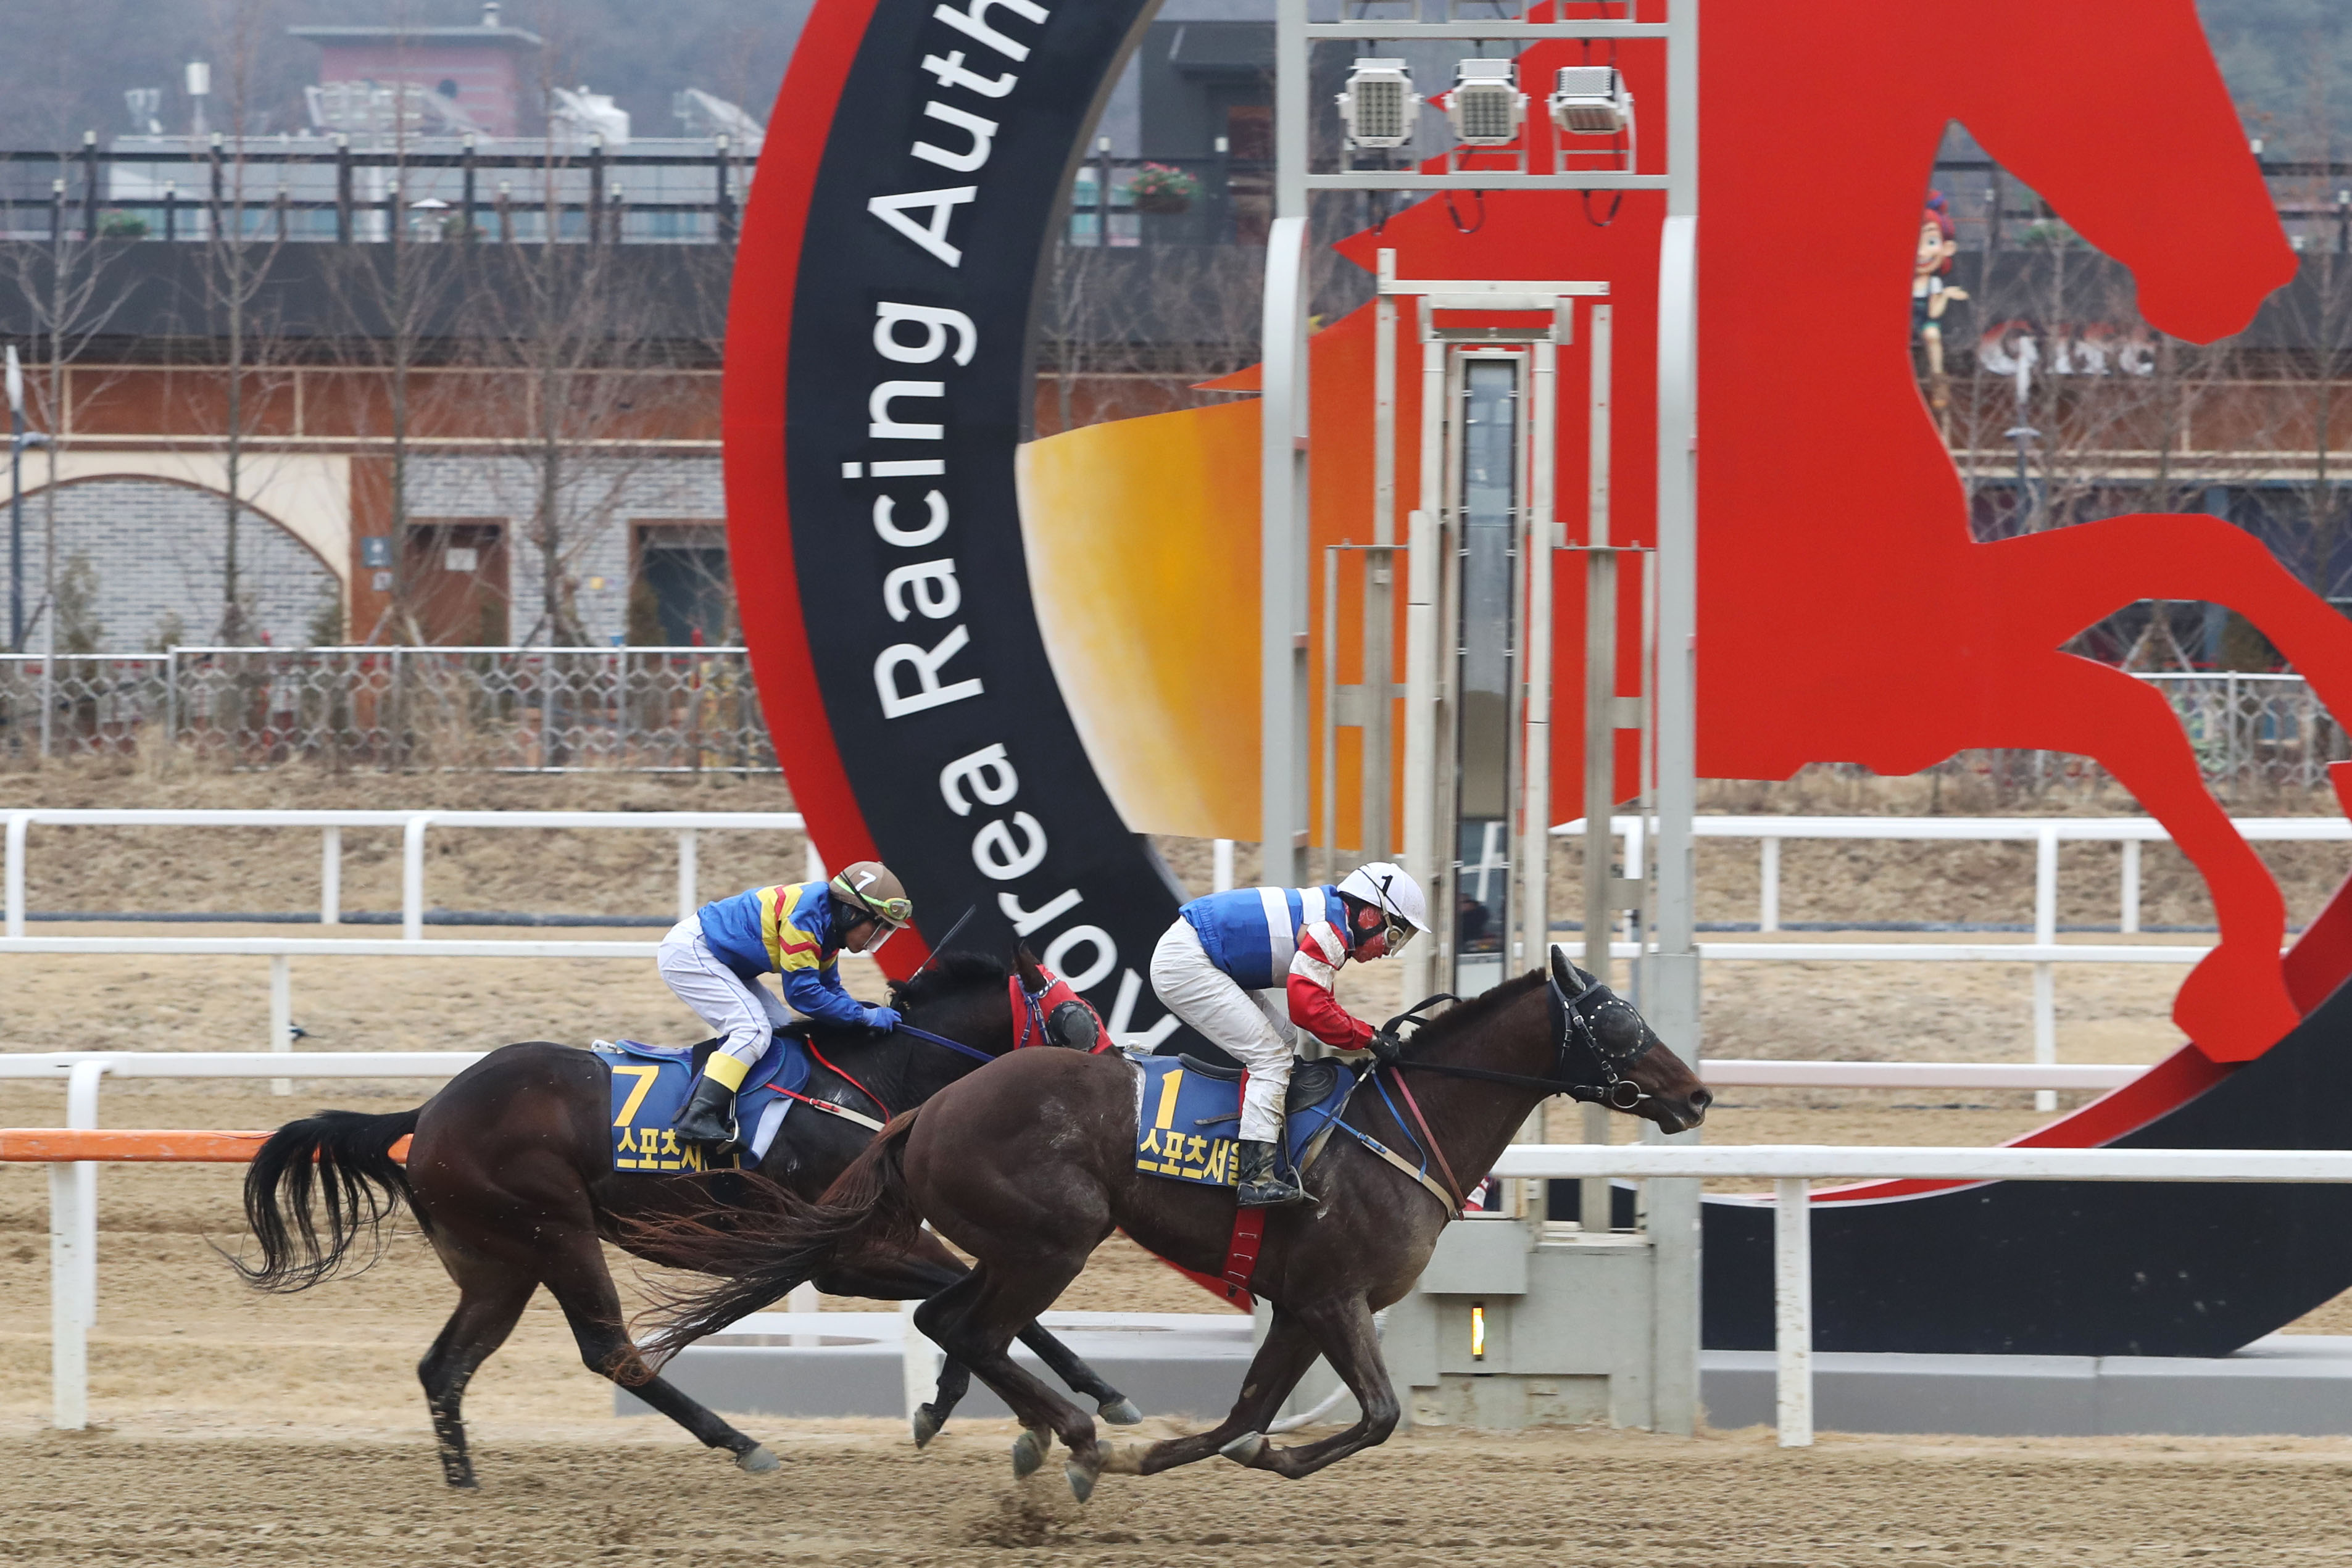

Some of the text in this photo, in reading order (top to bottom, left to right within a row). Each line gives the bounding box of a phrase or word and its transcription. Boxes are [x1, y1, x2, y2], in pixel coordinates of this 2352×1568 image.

[842, 301, 984, 720] Racing
[855, 870, 877, 892] 7
[1381, 874, 1394, 897] 1
[612, 1065, 660, 1127] 7
[1155, 1069, 1184, 1129] 1
[617, 1127, 702, 1172] 스포츠서
